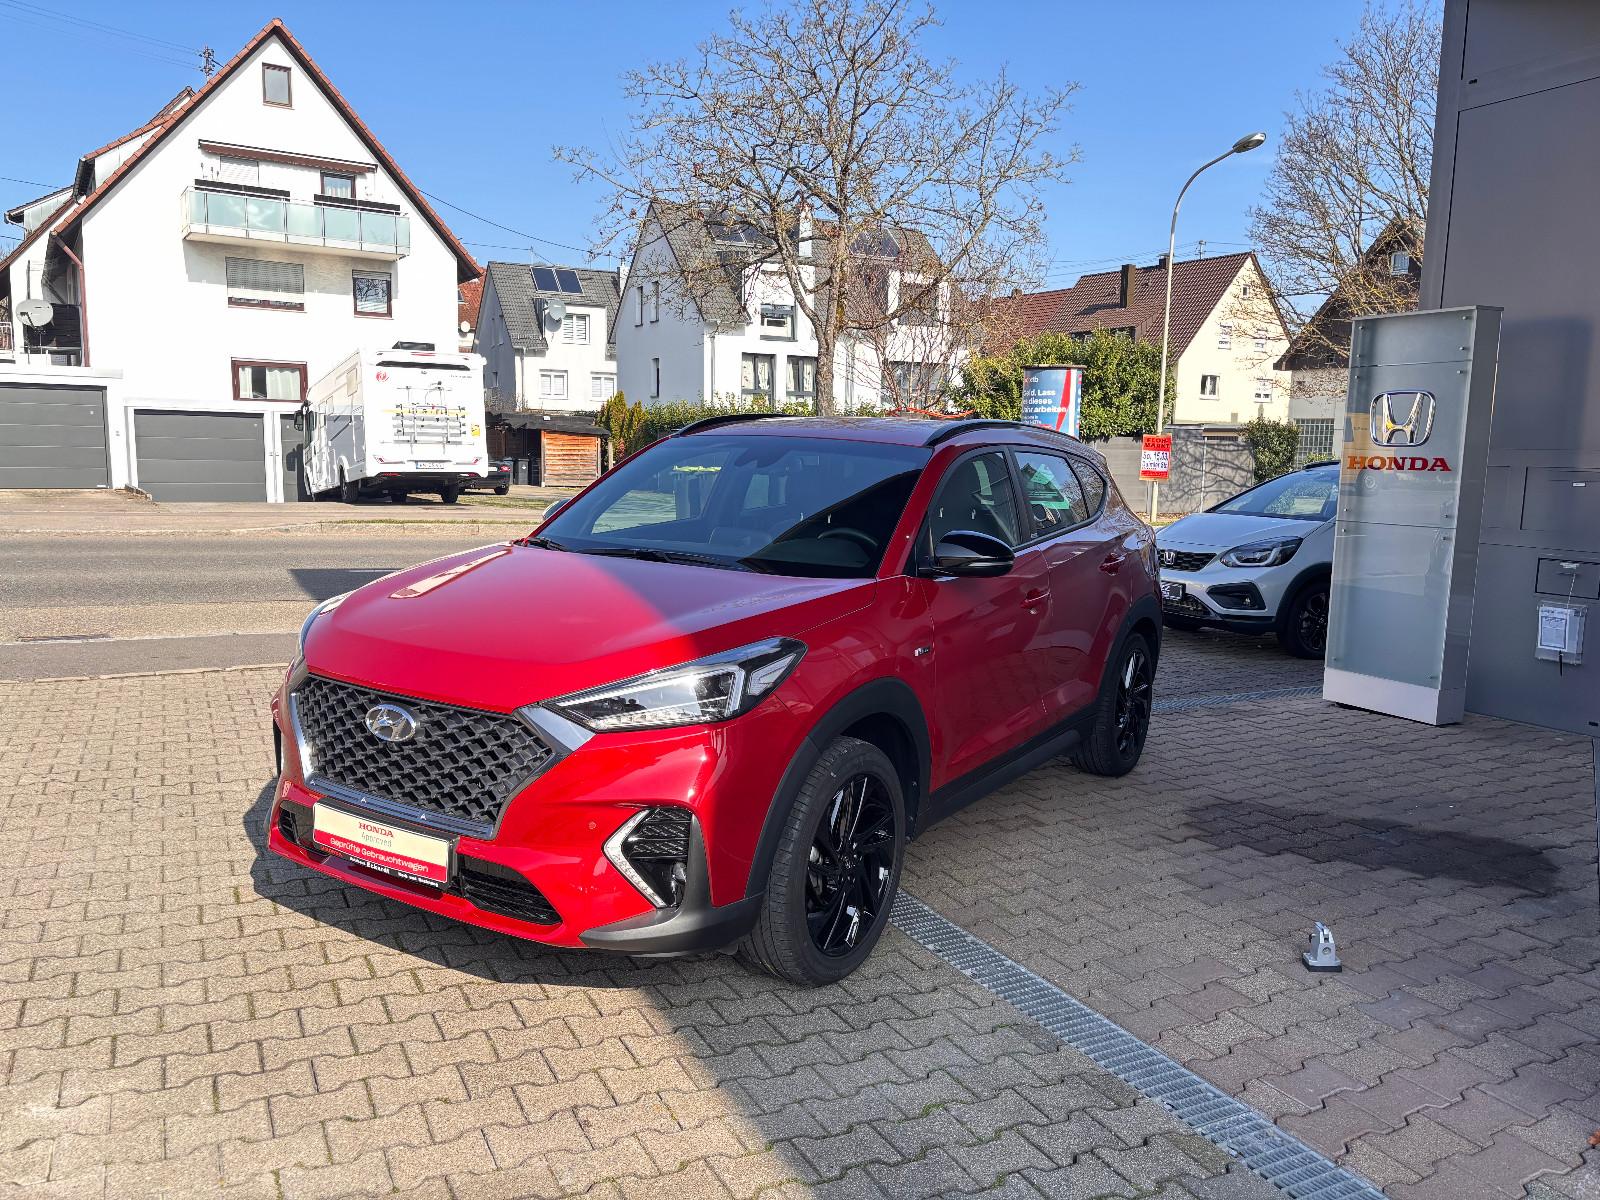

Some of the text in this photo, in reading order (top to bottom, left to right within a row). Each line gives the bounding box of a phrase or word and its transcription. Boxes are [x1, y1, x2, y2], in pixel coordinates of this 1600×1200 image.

[1029, 397, 1053, 405] dieses
[1347, 456, 1452, 472] HONDA
[358, 822, 395, 838] HONDA
[361, 832, 392, 847] Approved
[330, 837, 360, 853] Geprüfte
[361, 848, 429, 873] Gebrauchtwagen
